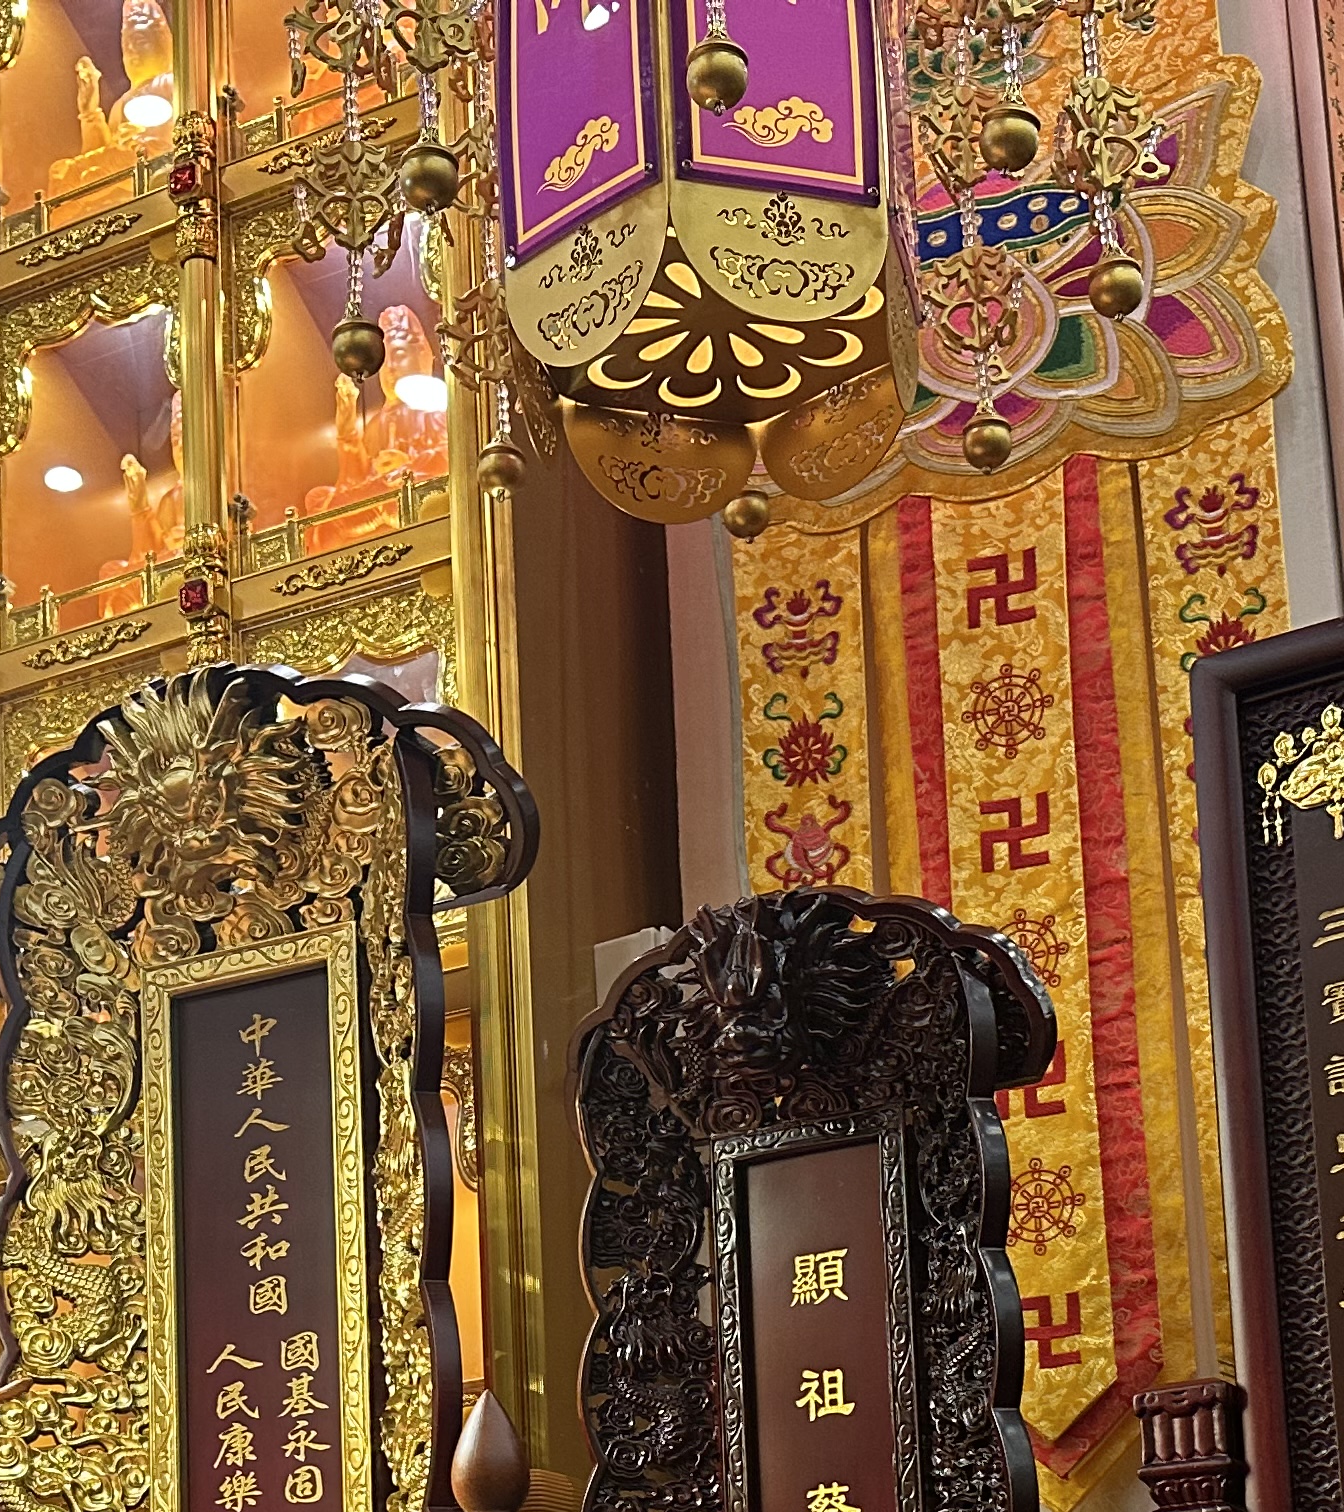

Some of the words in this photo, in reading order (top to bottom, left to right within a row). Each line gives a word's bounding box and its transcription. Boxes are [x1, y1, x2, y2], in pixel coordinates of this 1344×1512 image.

[234, 1013, 291, 1316] 中華人民共和國
[206, 1343, 263, 1512] 人民康樂
[277, 1331, 331, 1504] 國基永固
